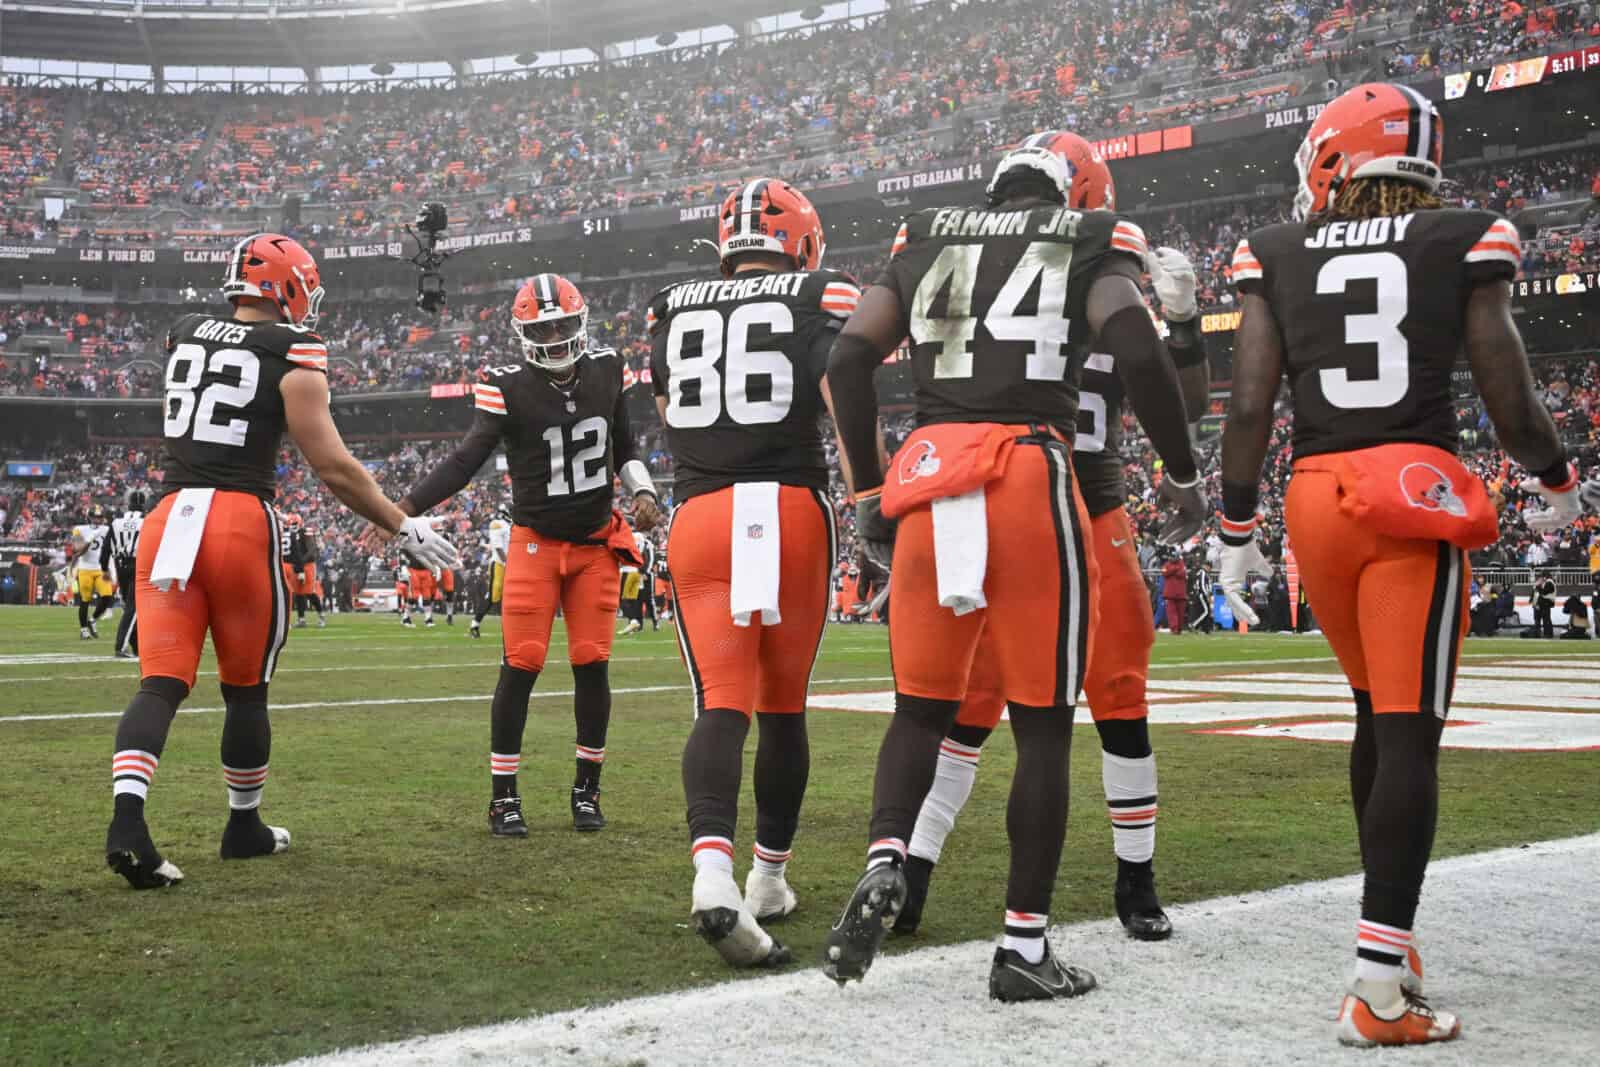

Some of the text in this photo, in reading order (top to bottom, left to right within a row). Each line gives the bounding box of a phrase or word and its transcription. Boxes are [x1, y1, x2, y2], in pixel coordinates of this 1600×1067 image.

[1552, 55, 1575, 74] 5:11
[1265, 110, 1303, 128] PAUL
[877, 163, 983, 194] OTTO GRAHAM 14
[680, 204, 717, 222] DANTE
[929, 207, 1083, 238] FANNIN JR
[728, 238, 765, 249] CLEVELAND
[1304, 212, 1416, 249] JEUDY
[183, 250, 234, 263] CLAY MAT
[666, 272, 811, 312] WHITEHEART
[910, 241, 1073, 381] 44
[193, 319, 254, 344] BATES
[1316, 252, 1409, 409] 3
[665, 302, 794, 428] 86
[163, 344, 260, 447] 82
[542, 416, 608, 496] 12
